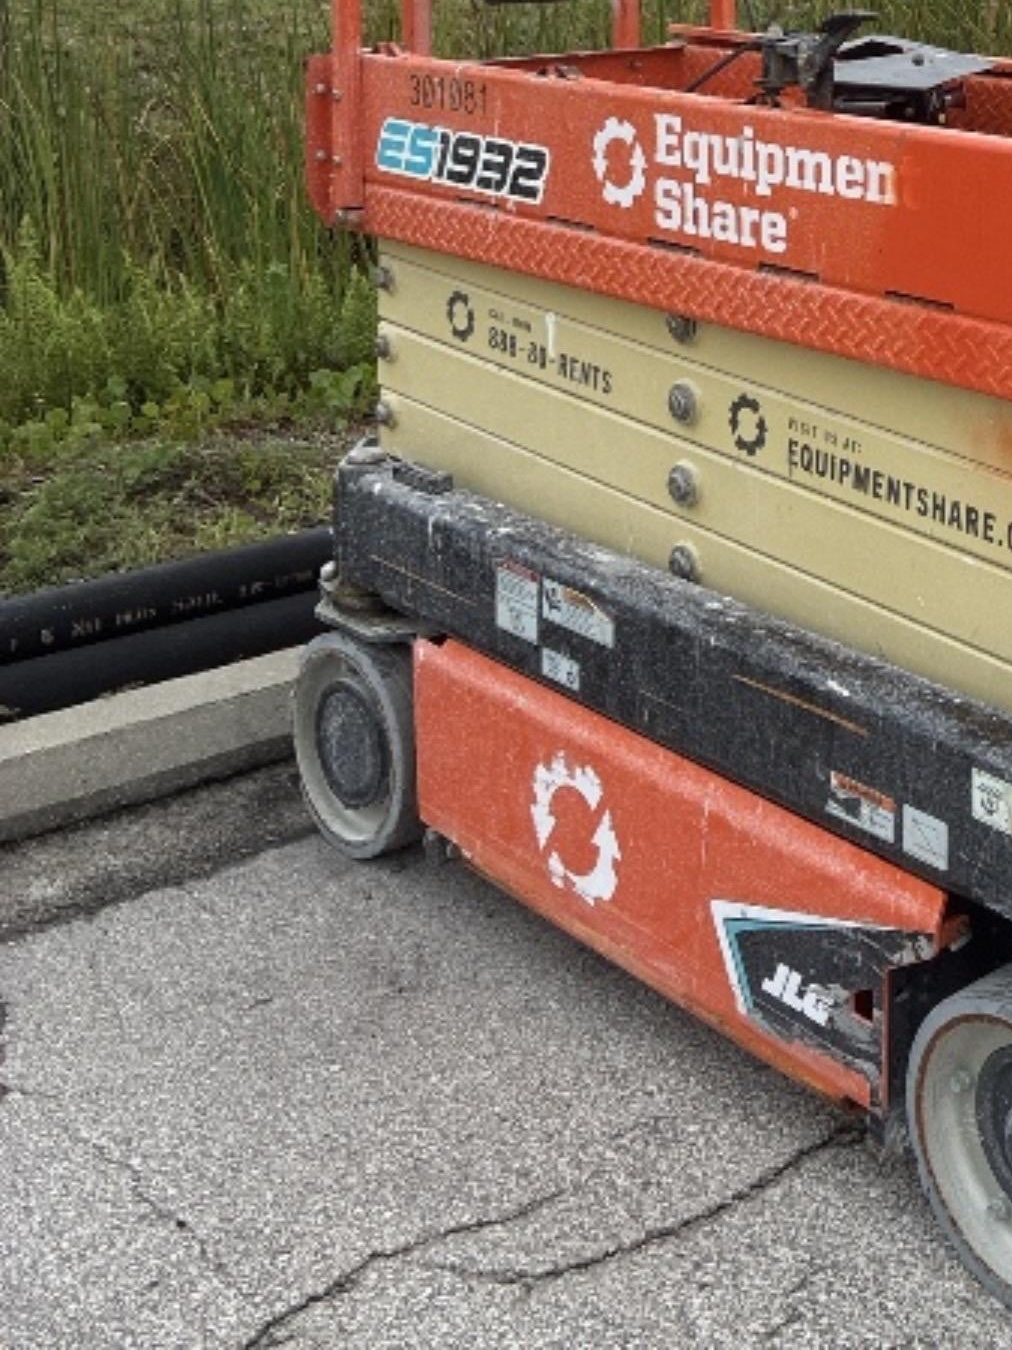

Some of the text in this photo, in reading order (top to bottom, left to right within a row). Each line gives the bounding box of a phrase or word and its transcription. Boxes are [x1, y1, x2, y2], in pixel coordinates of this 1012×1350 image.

[409, 74, 489, 115] 301081
[376, 117, 549, 204] ES1932
[654, 177, 788, 253] Share
[761, 962, 834, 1027] JLG
